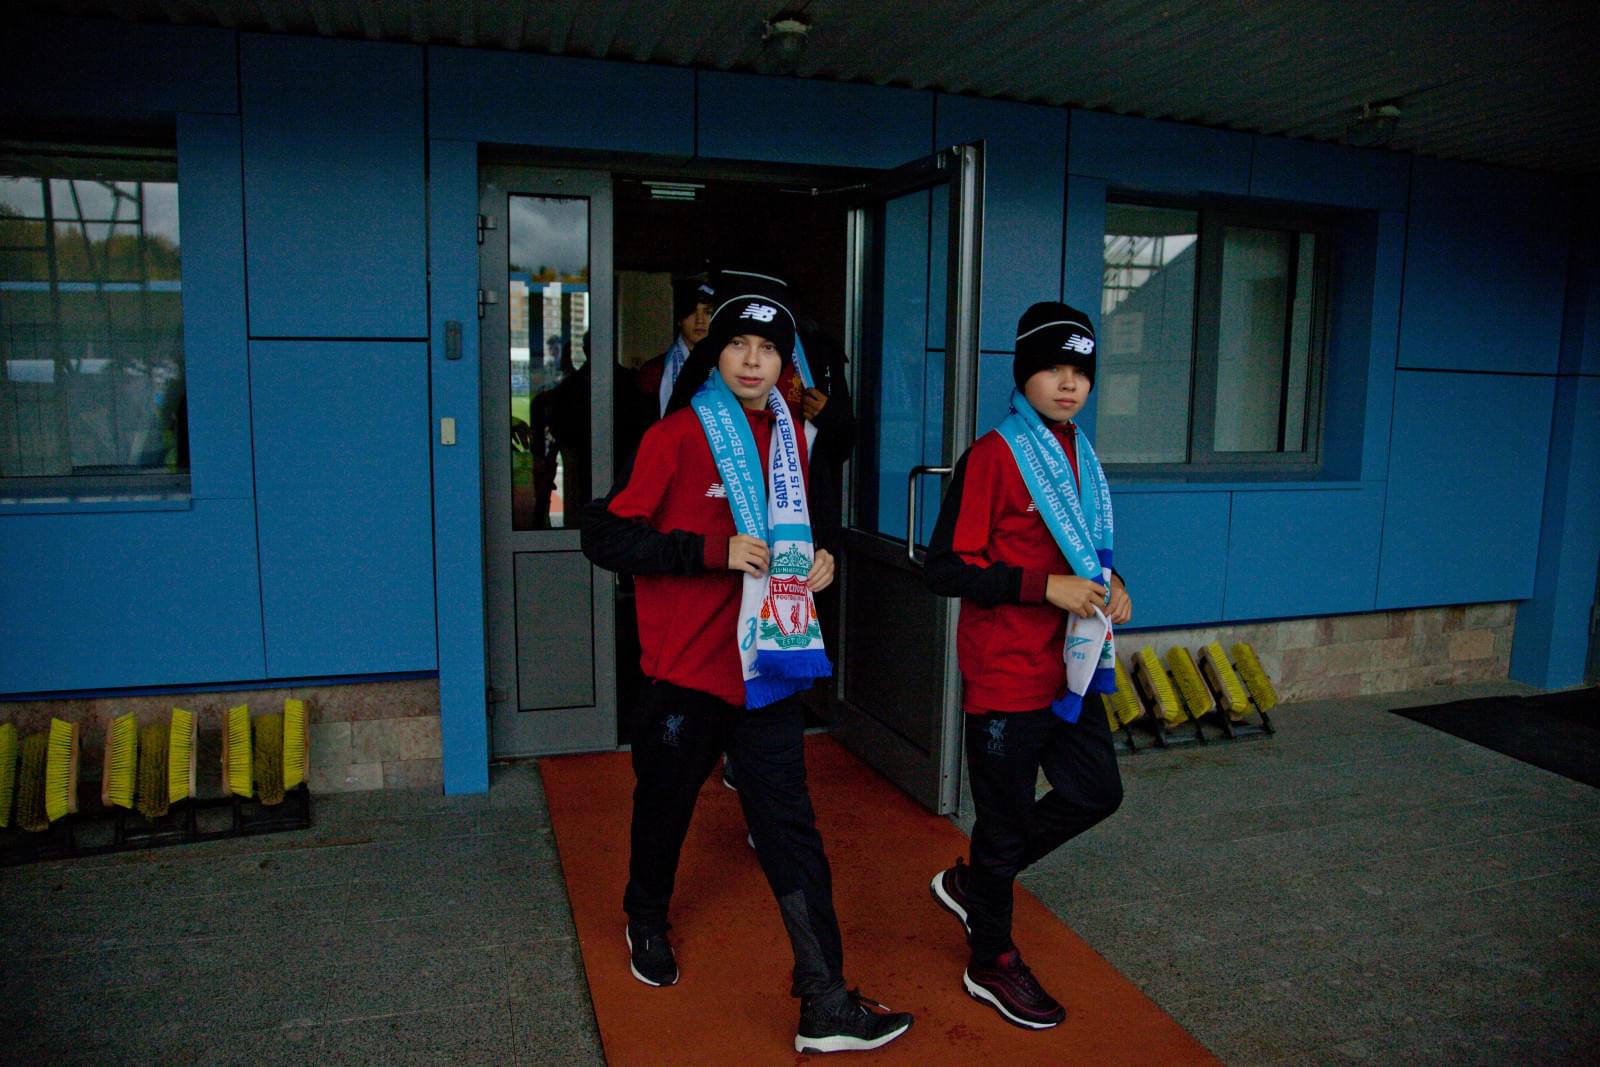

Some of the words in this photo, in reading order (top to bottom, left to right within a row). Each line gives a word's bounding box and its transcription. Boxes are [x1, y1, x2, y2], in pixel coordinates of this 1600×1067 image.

[739, 303, 777, 323] NB
[1061, 333, 1095, 355] NB
[698, 405, 727, 454] ТУРНИР
[780, 418, 798, 472] OCTOBER
[774, 473, 789, 509] SAINT
[790, 476, 800, 489] 15
[1015, 432, 1086, 553] МЕЖДУНАРОДНЫЙ
[793, 499, 803, 513] 14
